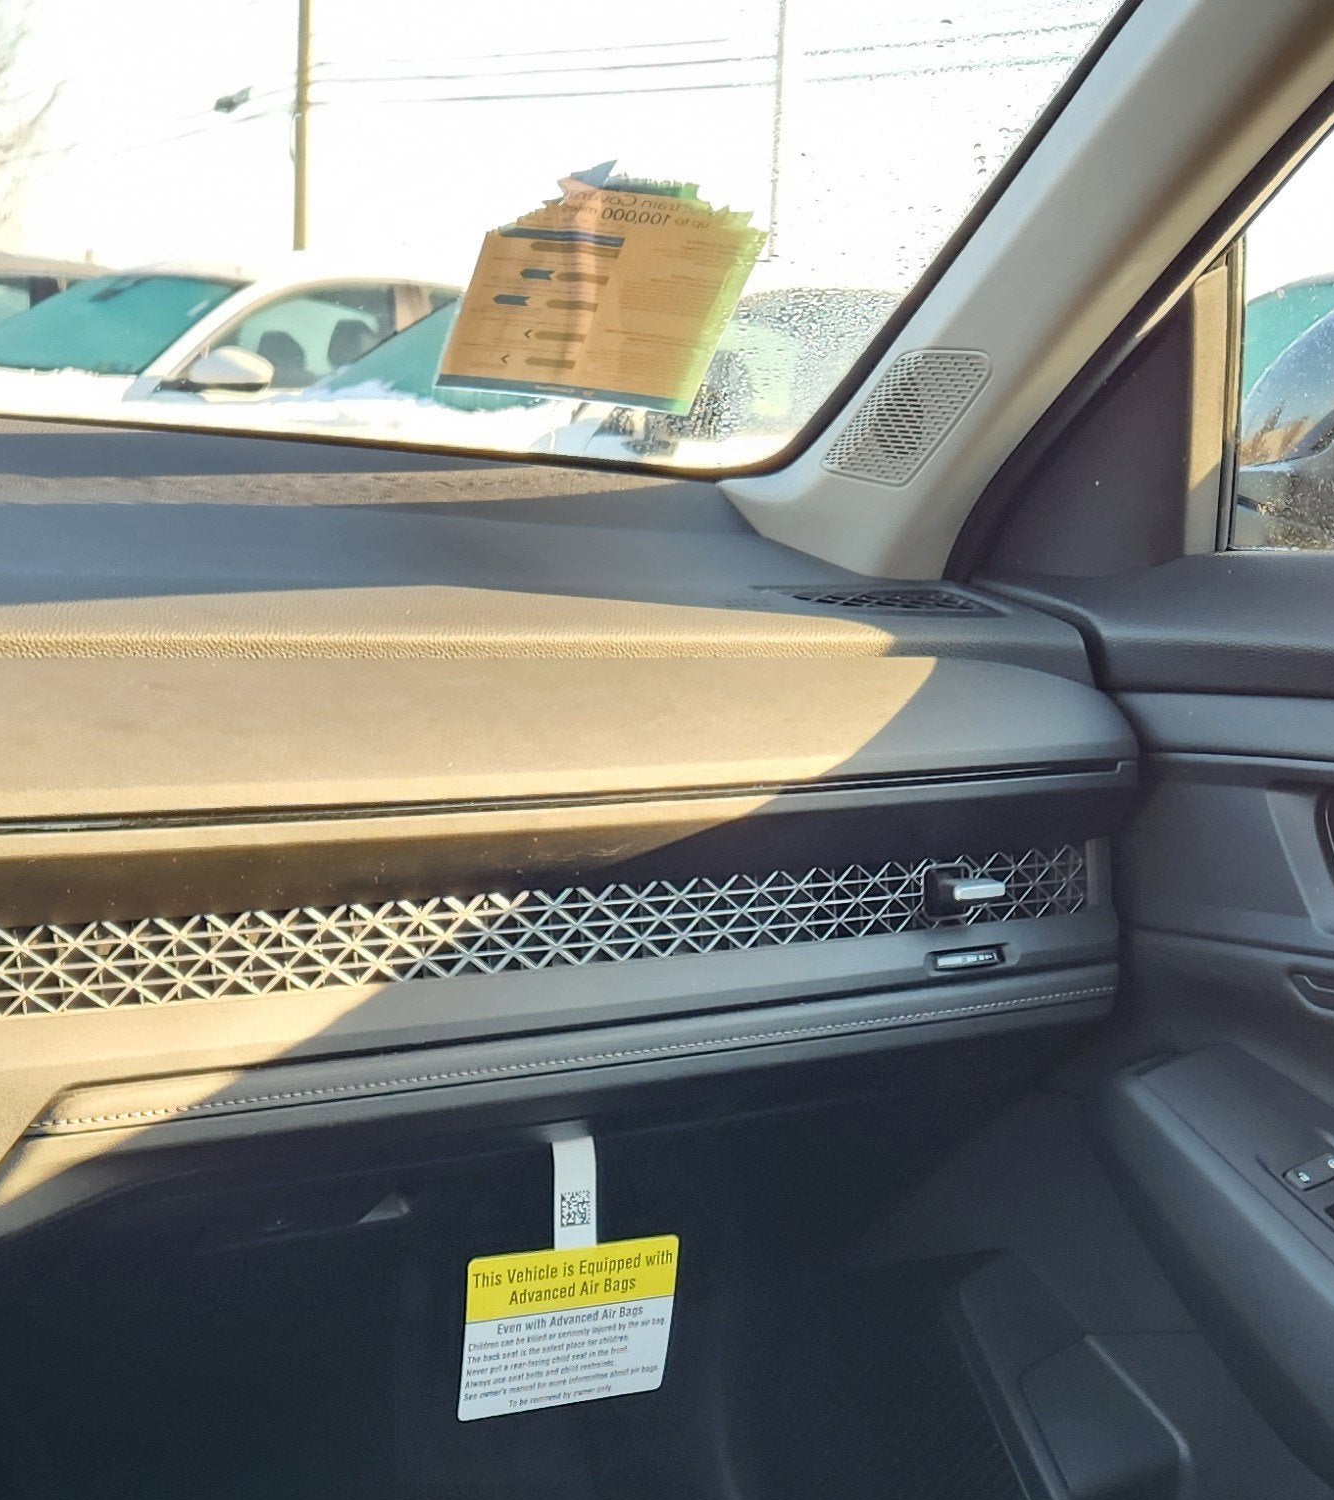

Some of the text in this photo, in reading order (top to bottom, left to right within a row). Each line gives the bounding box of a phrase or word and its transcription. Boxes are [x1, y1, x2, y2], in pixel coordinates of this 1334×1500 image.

[473, 1249, 673, 1288] This Vehicle is Equipped with
[509, 1278, 636, 1305] Advanced Air Bags
[497, 1306, 643, 1335] Even with Advanced Air Bags
[468, 1355, 481, 1364] The
